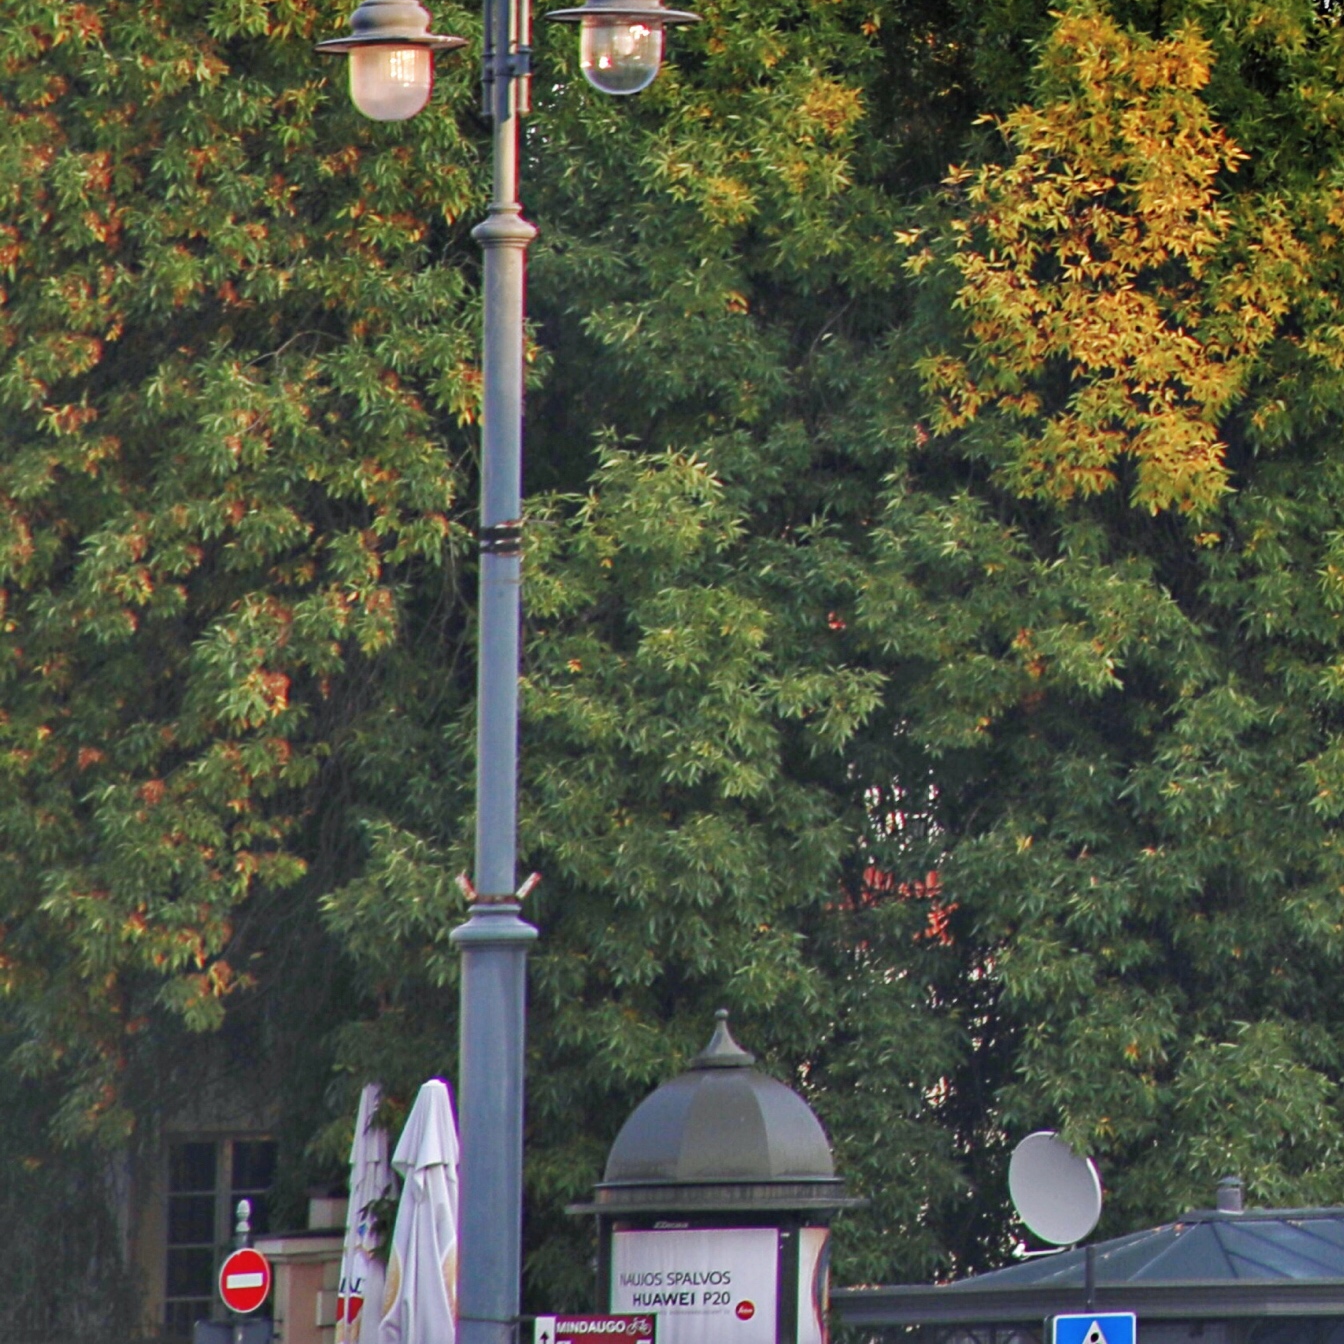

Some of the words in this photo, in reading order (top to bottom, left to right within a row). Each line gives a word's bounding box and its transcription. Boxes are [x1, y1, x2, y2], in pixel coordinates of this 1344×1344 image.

[620, 1272, 662, 1287] NAUJOS
[667, 1270, 731, 1286] SPALVOS
[632, 1291, 695, 1307] HUAWEI
[703, 1291, 731, 1306] P20
[556, 1320, 626, 1334] MINDAUGO
